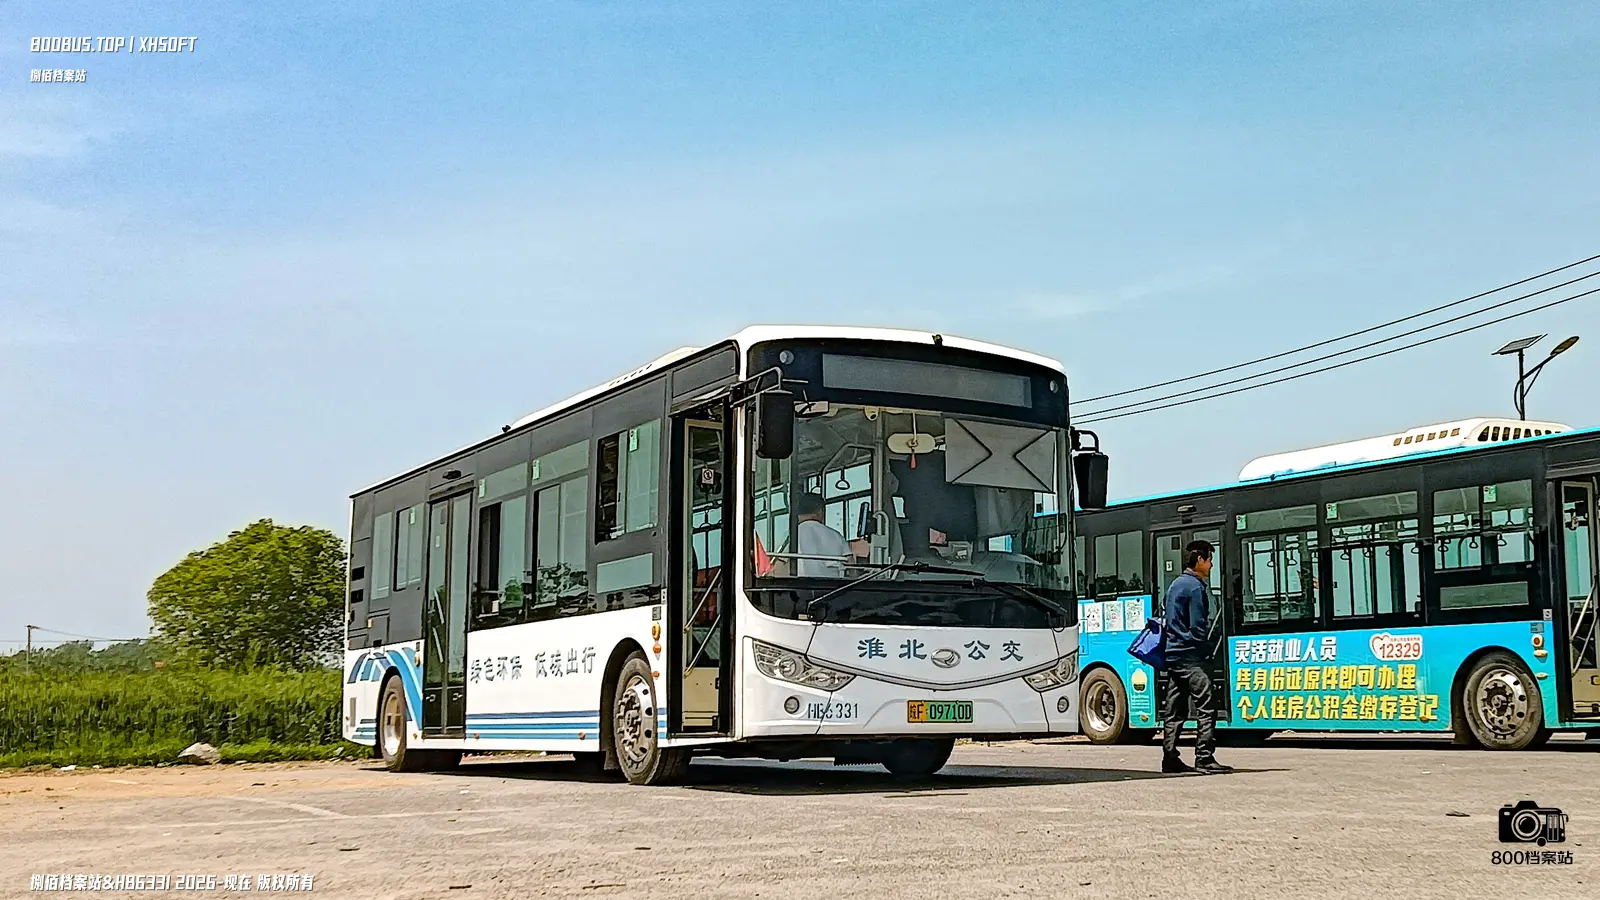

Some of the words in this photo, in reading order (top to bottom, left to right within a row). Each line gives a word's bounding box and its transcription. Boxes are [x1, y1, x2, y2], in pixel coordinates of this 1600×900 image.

[1234, 636, 1337, 664] 灵活就业人员
[1379, 642, 1421, 659] 12329
[470, 655, 522, 684] 绿色环保
[534, 646, 596, 678] 低碳出行
[1236, 664, 1417, 691] 凭身份证原件即可办理
[1237, 694, 1439, 721] 个人住房公积金缴存登记
